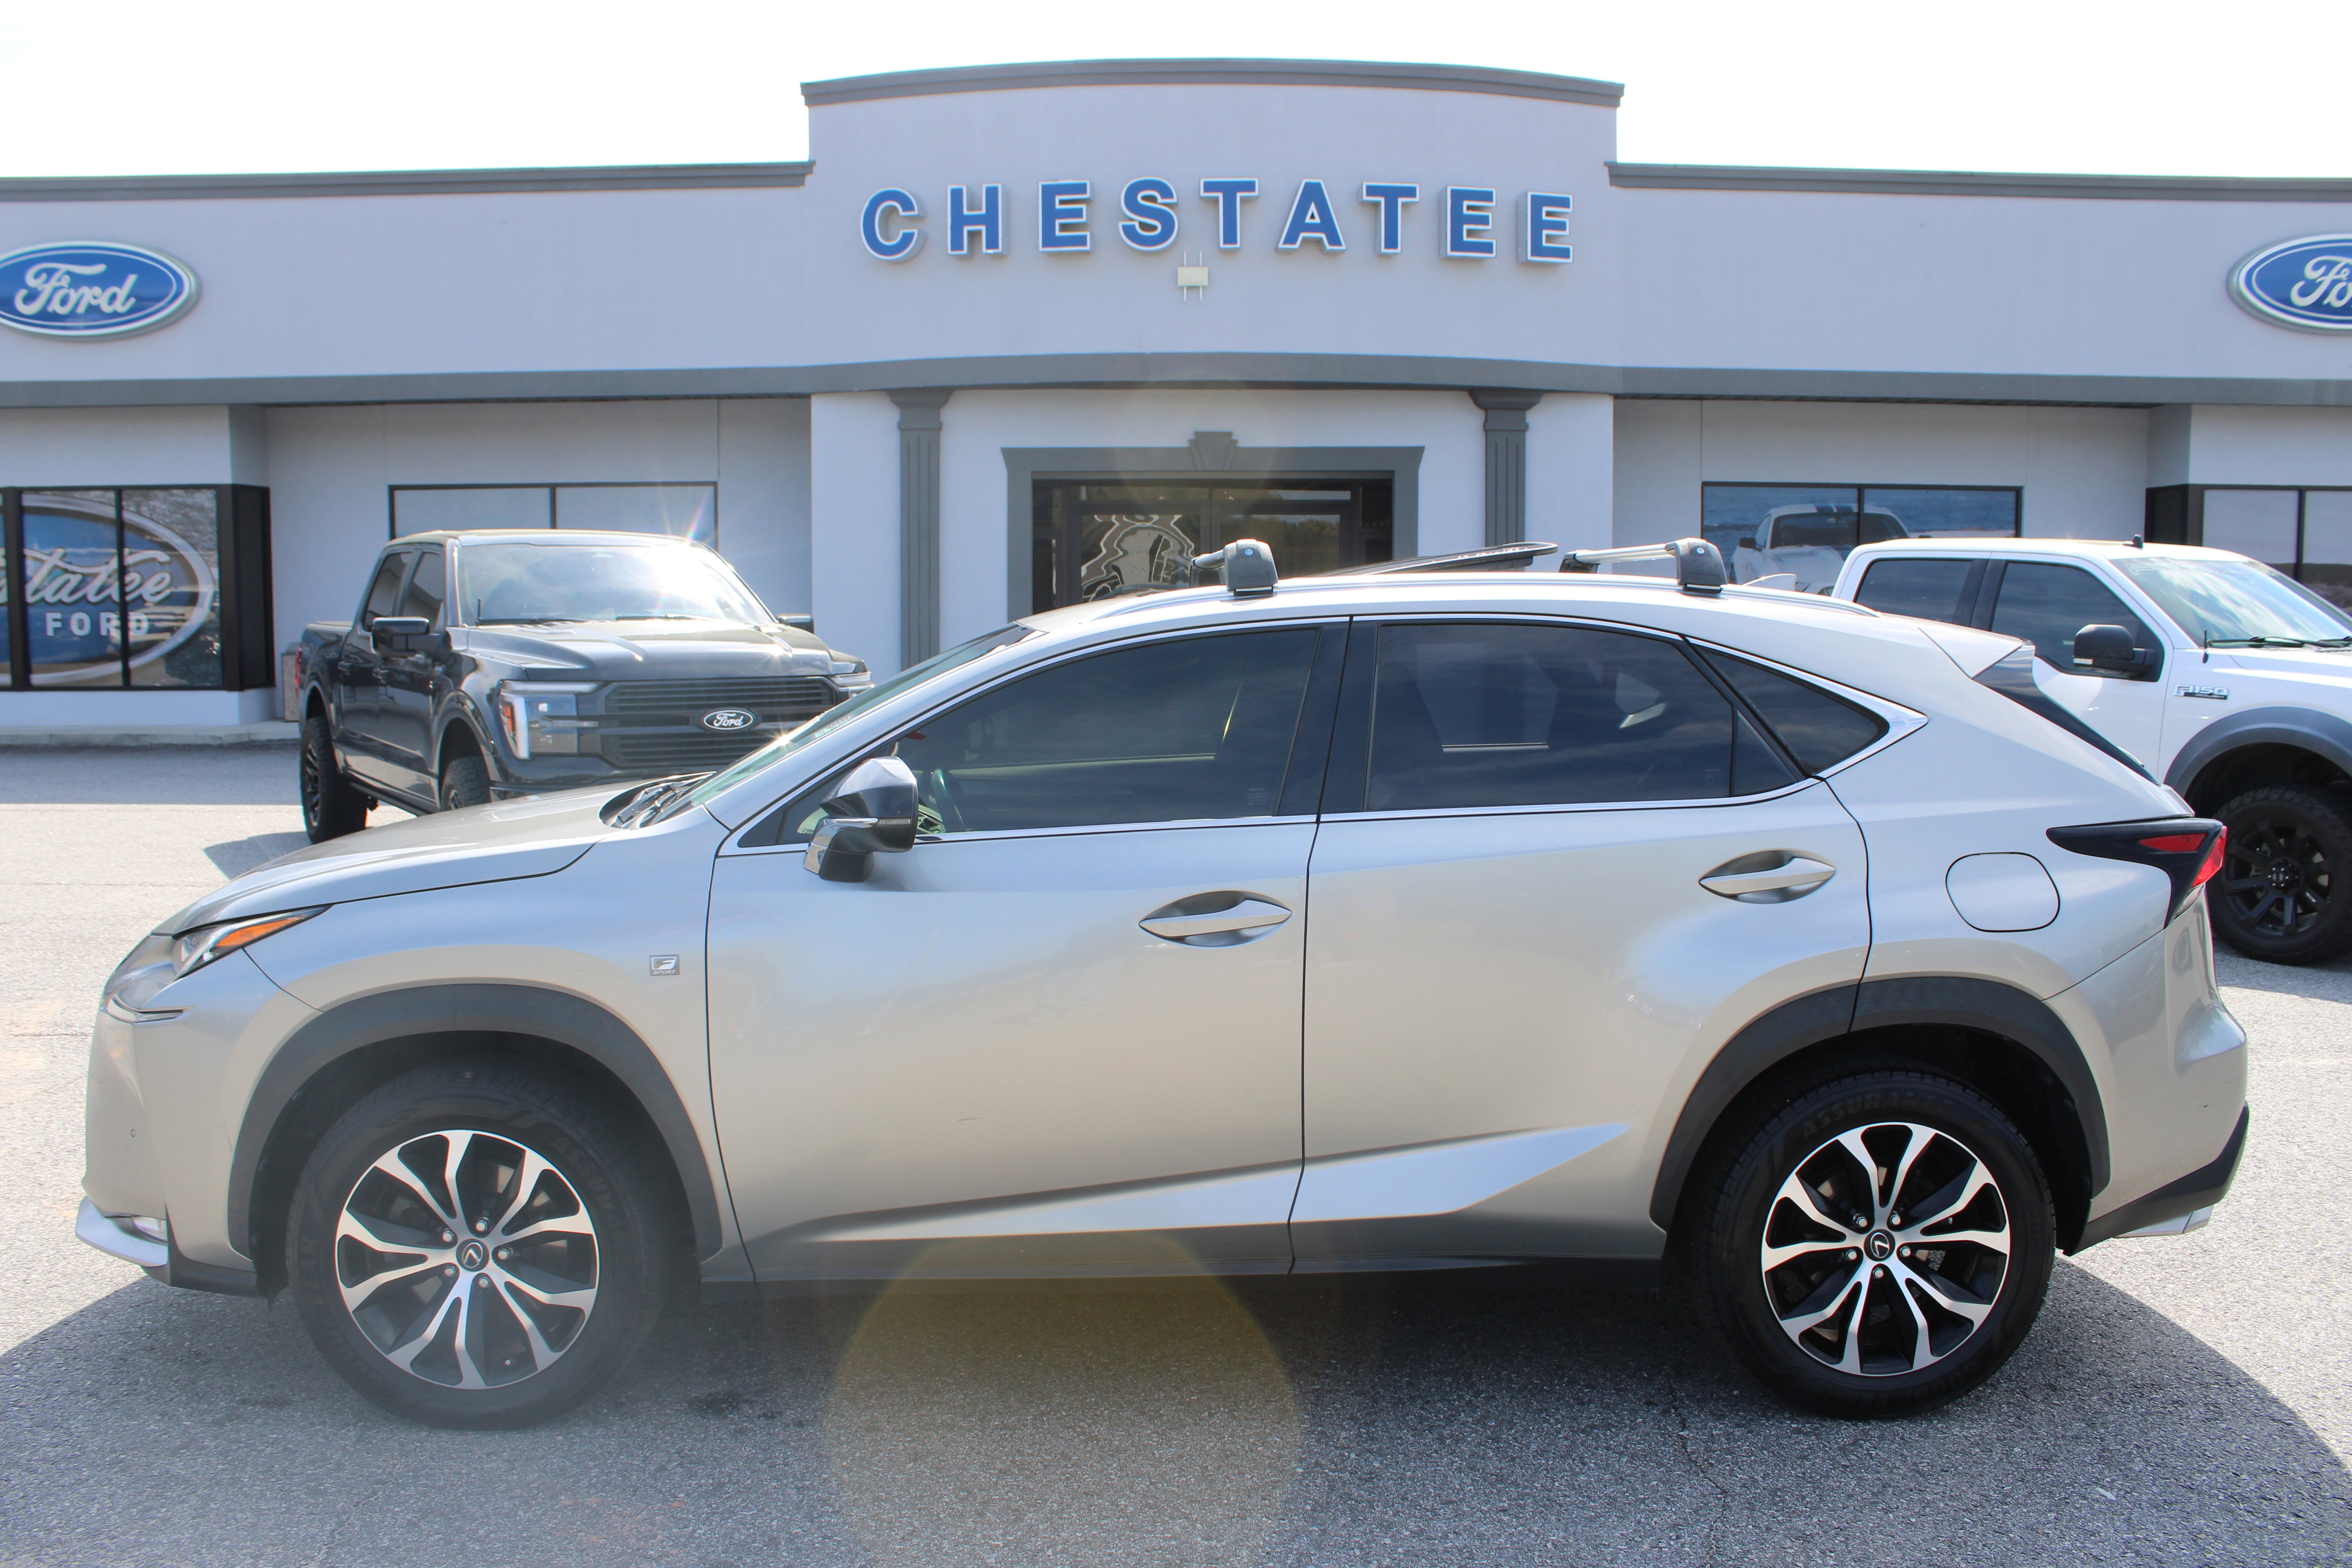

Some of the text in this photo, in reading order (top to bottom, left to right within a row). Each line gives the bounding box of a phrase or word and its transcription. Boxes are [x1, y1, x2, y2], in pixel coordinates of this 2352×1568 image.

[860, 176, 1575, 265] CHESTATEE
[15, 262, 138, 315] Ford
[2290, 255, 2352, 307] Fo
[0, 547, 172, 605] tatee
[45, 612, 149, 636] FORD
[713, 713, 744, 727] Ford
